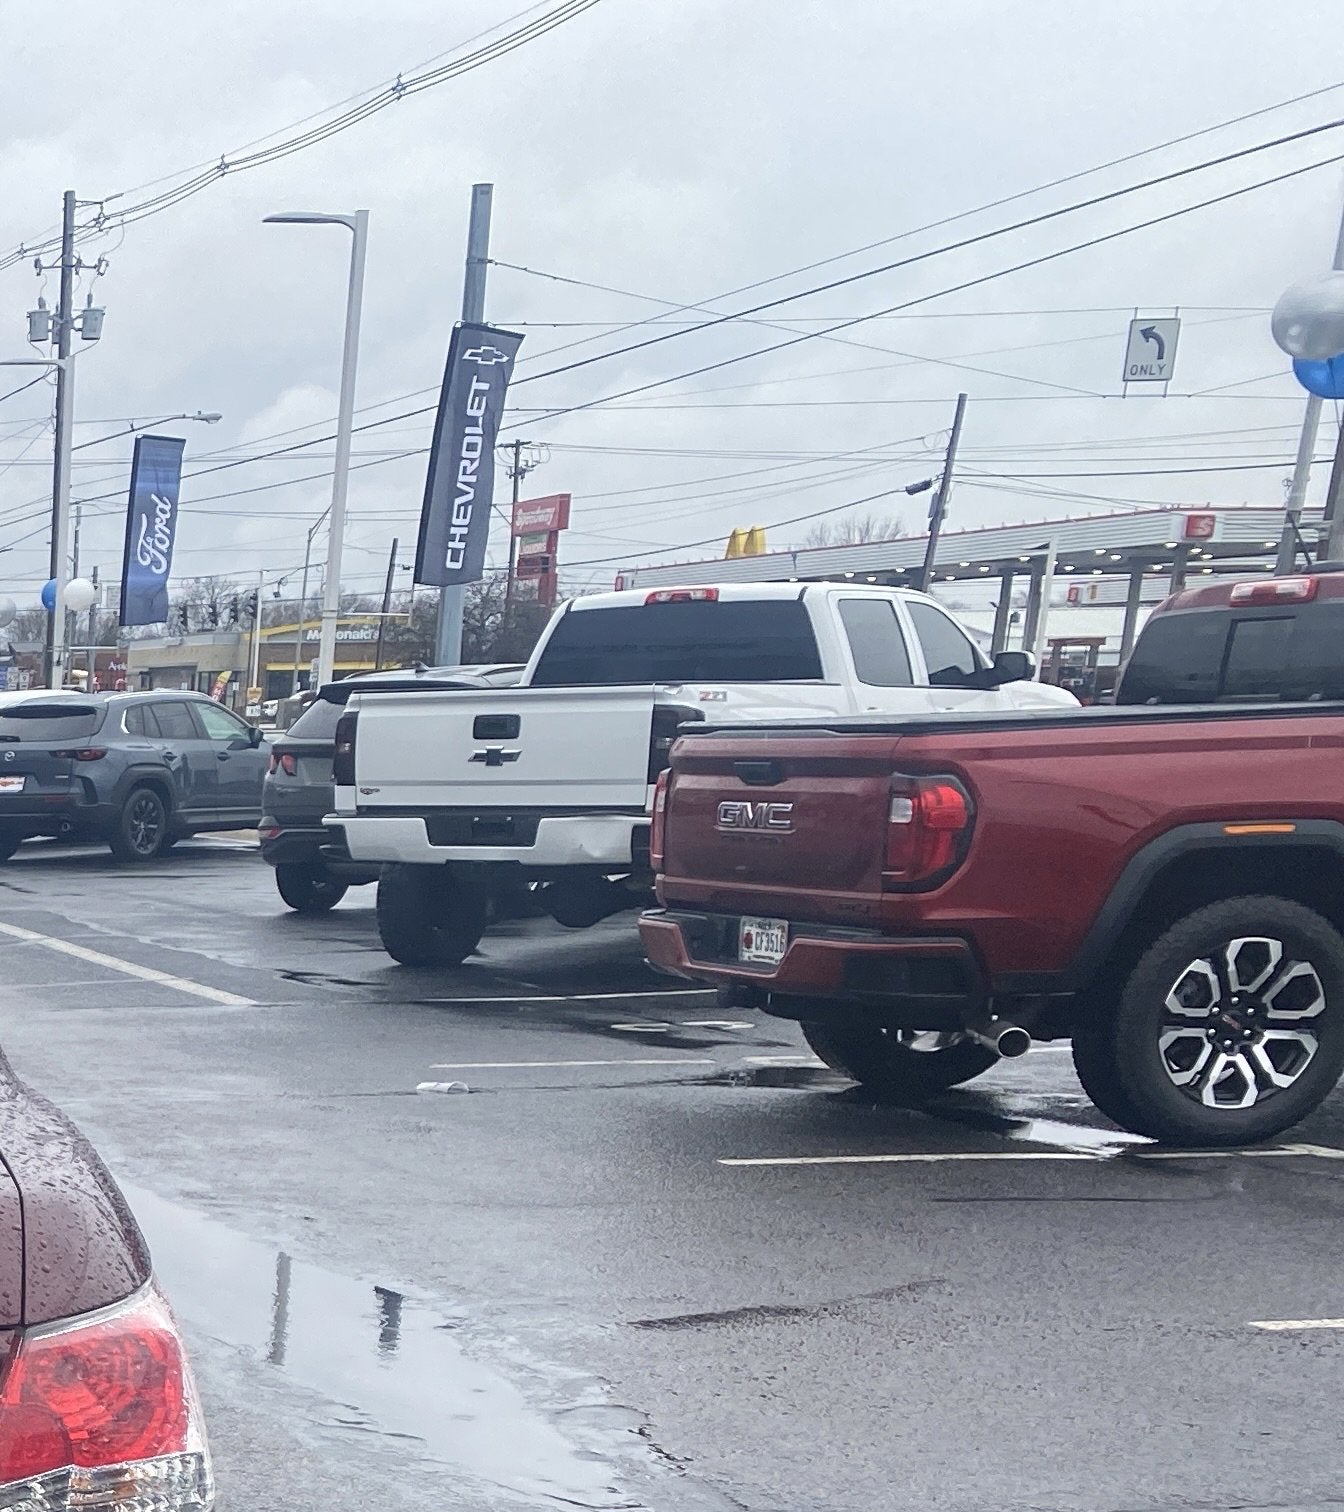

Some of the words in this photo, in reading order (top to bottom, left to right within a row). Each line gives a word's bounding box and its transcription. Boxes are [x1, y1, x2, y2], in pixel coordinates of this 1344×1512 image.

[1130, 364, 1166, 376] ONLY
[445, 375, 490, 569] CHEVROLET
[137, 494, 172, 574] Ford
[306, 629, 380, 641] Monald's
[718, 801, 793, 829] GMC
